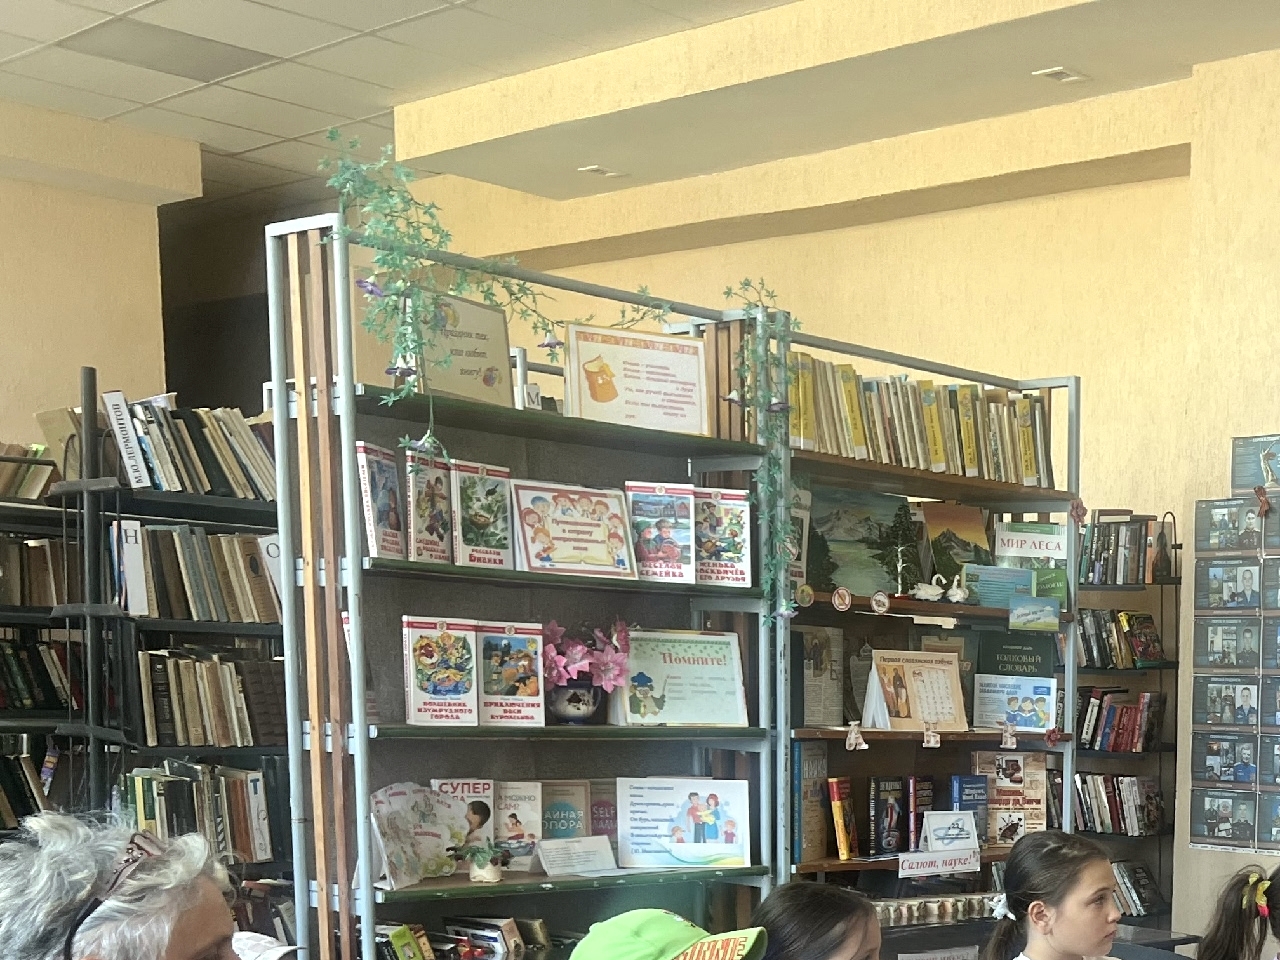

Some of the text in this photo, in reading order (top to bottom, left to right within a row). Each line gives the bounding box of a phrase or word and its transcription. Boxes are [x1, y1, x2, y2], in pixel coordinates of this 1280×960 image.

[528, 391, 541, 406] М
[123, 528, 139, 545] Н
[1000, 537, 1062, 552] МИР ЛЕСА
[661, 652, 728, 666] Помните!
[438, 782, 491, 794] СУПЕР
[544, 810, 584, 819] АЙНАЯ
[901, 855, 973, 871] Салют, науке!
